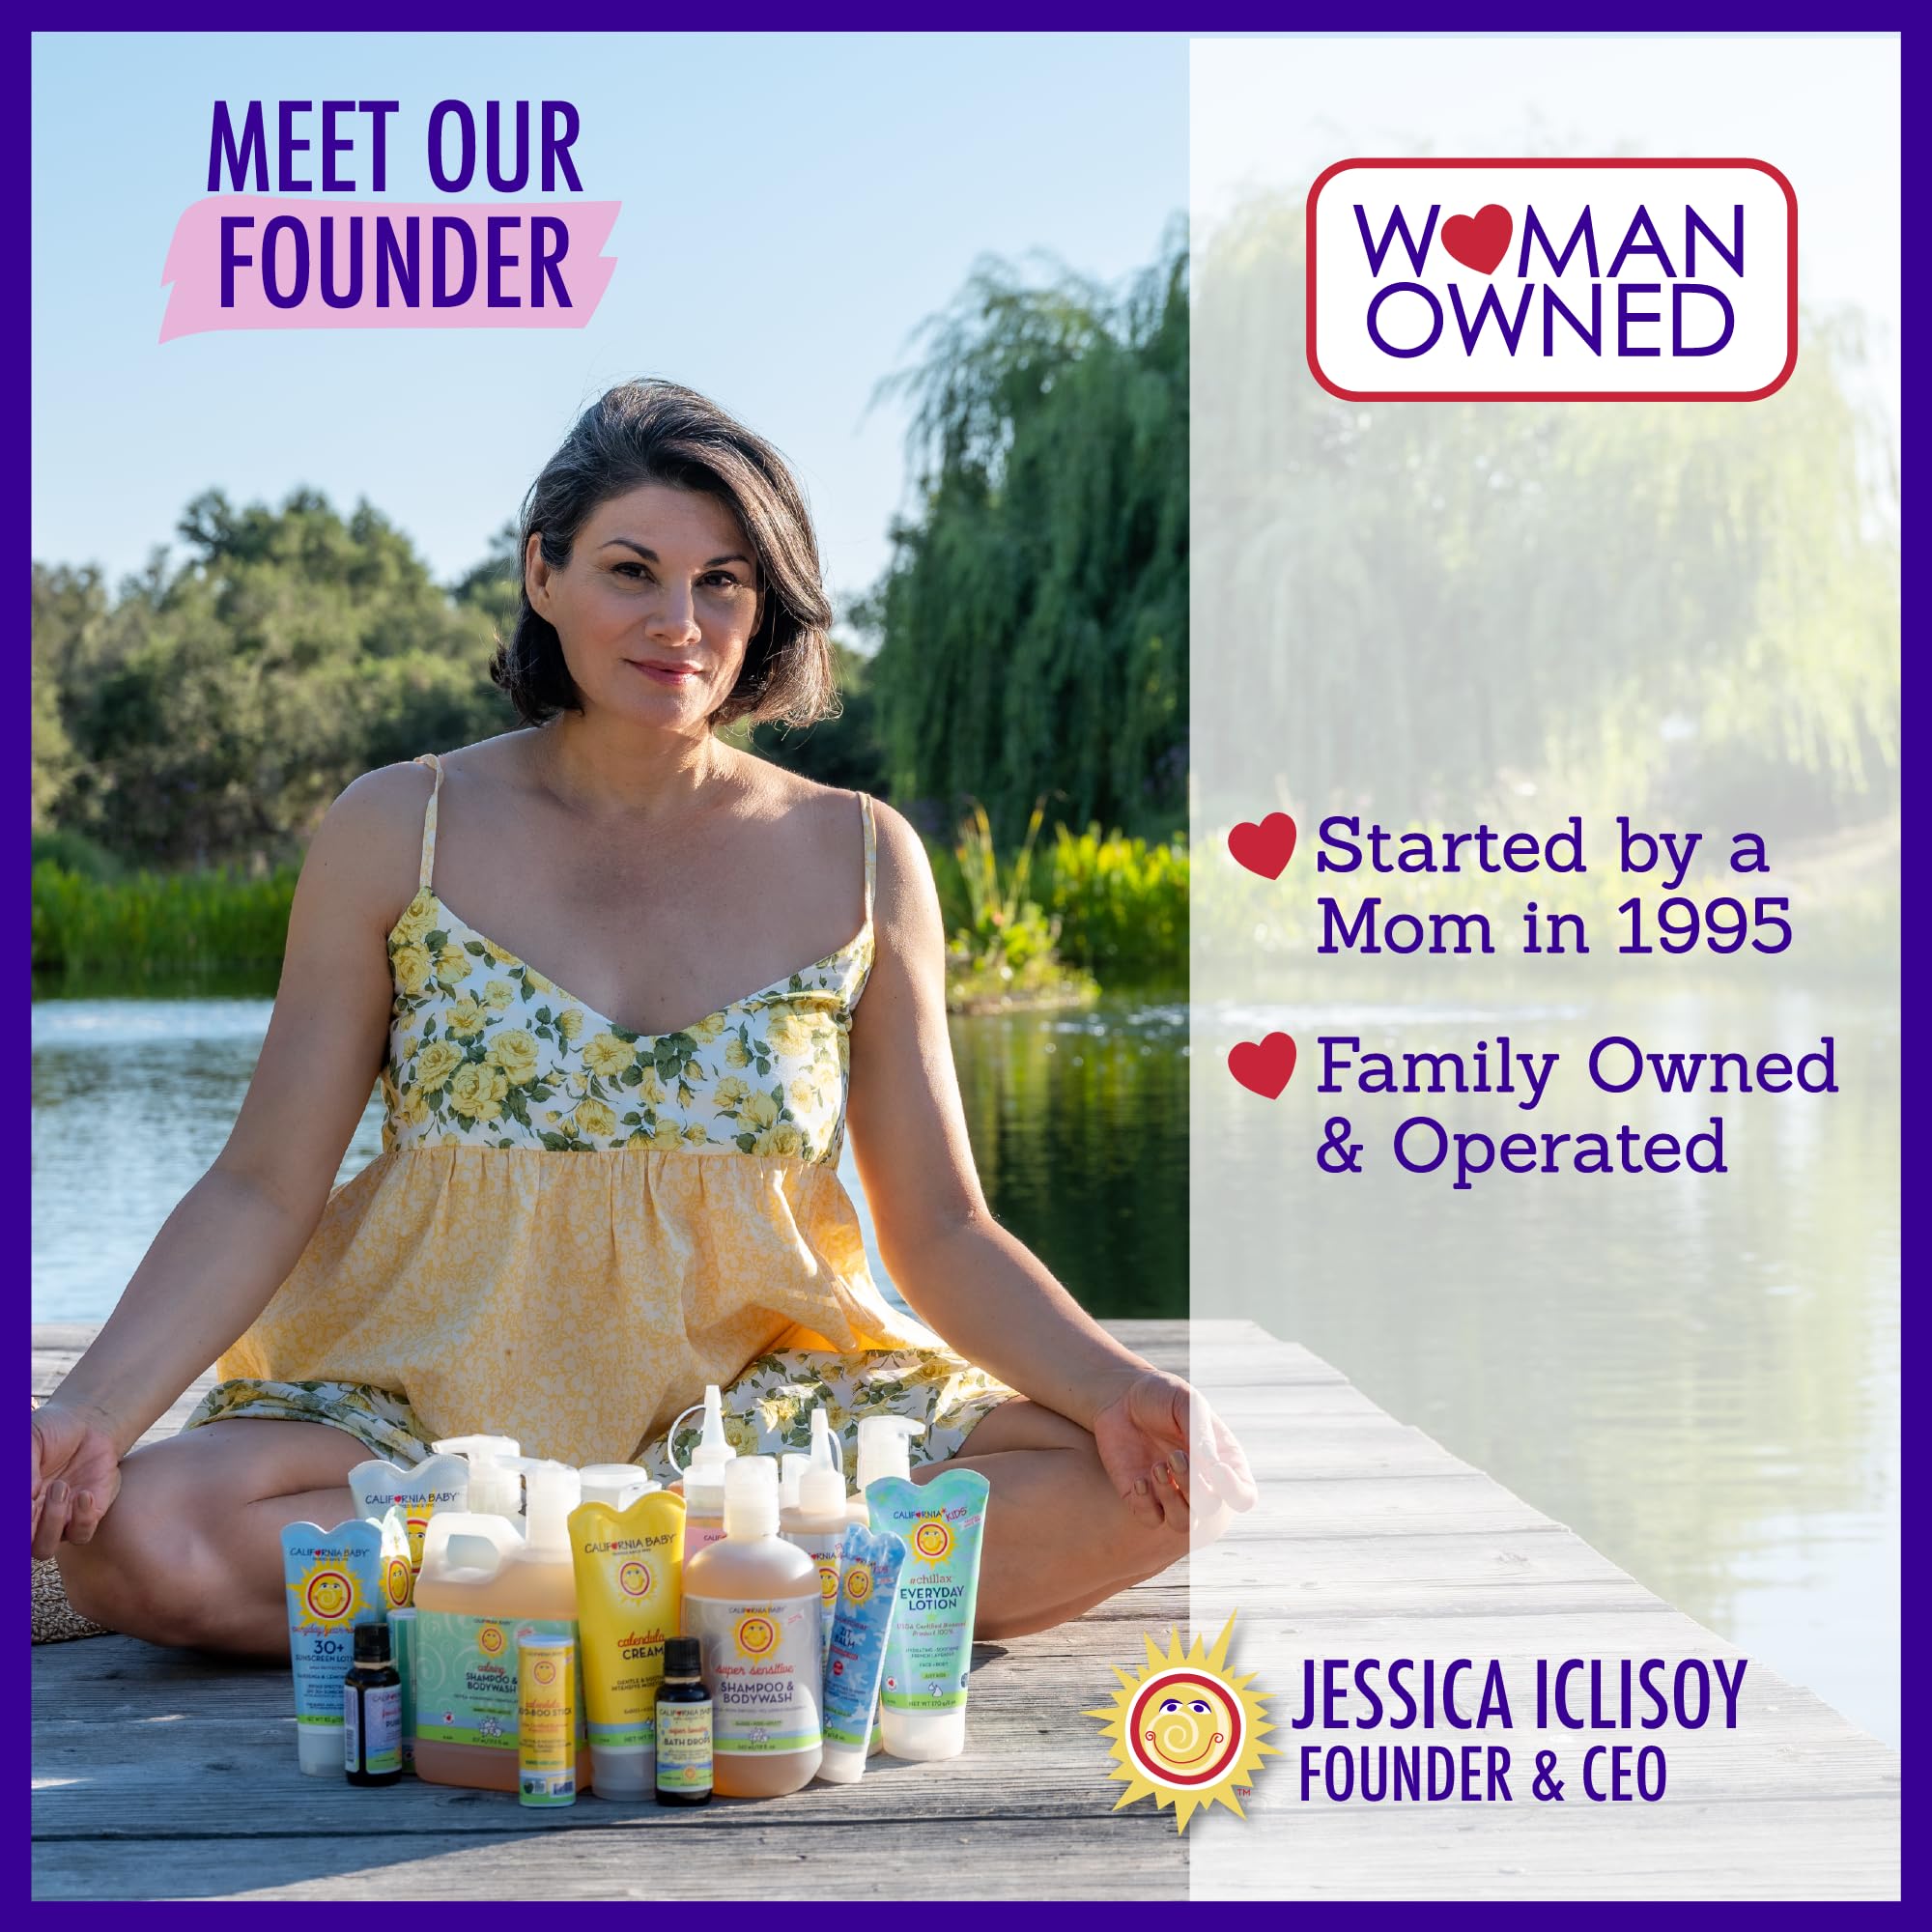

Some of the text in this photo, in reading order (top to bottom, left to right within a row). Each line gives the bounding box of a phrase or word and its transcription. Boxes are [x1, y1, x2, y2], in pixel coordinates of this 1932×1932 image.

[428, 1492, 457, 1502] BABY
[946, 1507, 968, 1521] KIDS
[644, 1533, 674, 1546] BABY
[344, 1548, 369, 1557] BABY
[910, 1574, 952, 1585] #chillax
[900, 1585, 964, 1600] EVERYDAY
[909, 1598, 957, 1611] LOTION
[617, 1628, 666, 1648] calendula
[314, 1640, 344, 1655] 30+
[622, 1646, 664, 1661] CREAM
[296, 1654, 335, 1662] SUNSCREEN
[716, 1662, 794, 1679] super sensitive
[466, 1672, 510, 1685] SHAMPOO
[468, 1682, 517, 1693] BODYWASH
[721, 1681, 794, 1692] SHAMPOO &
[724, 1692, 793, 1704] BODYWASH
[664, 1738, 685, 1747] BATH
